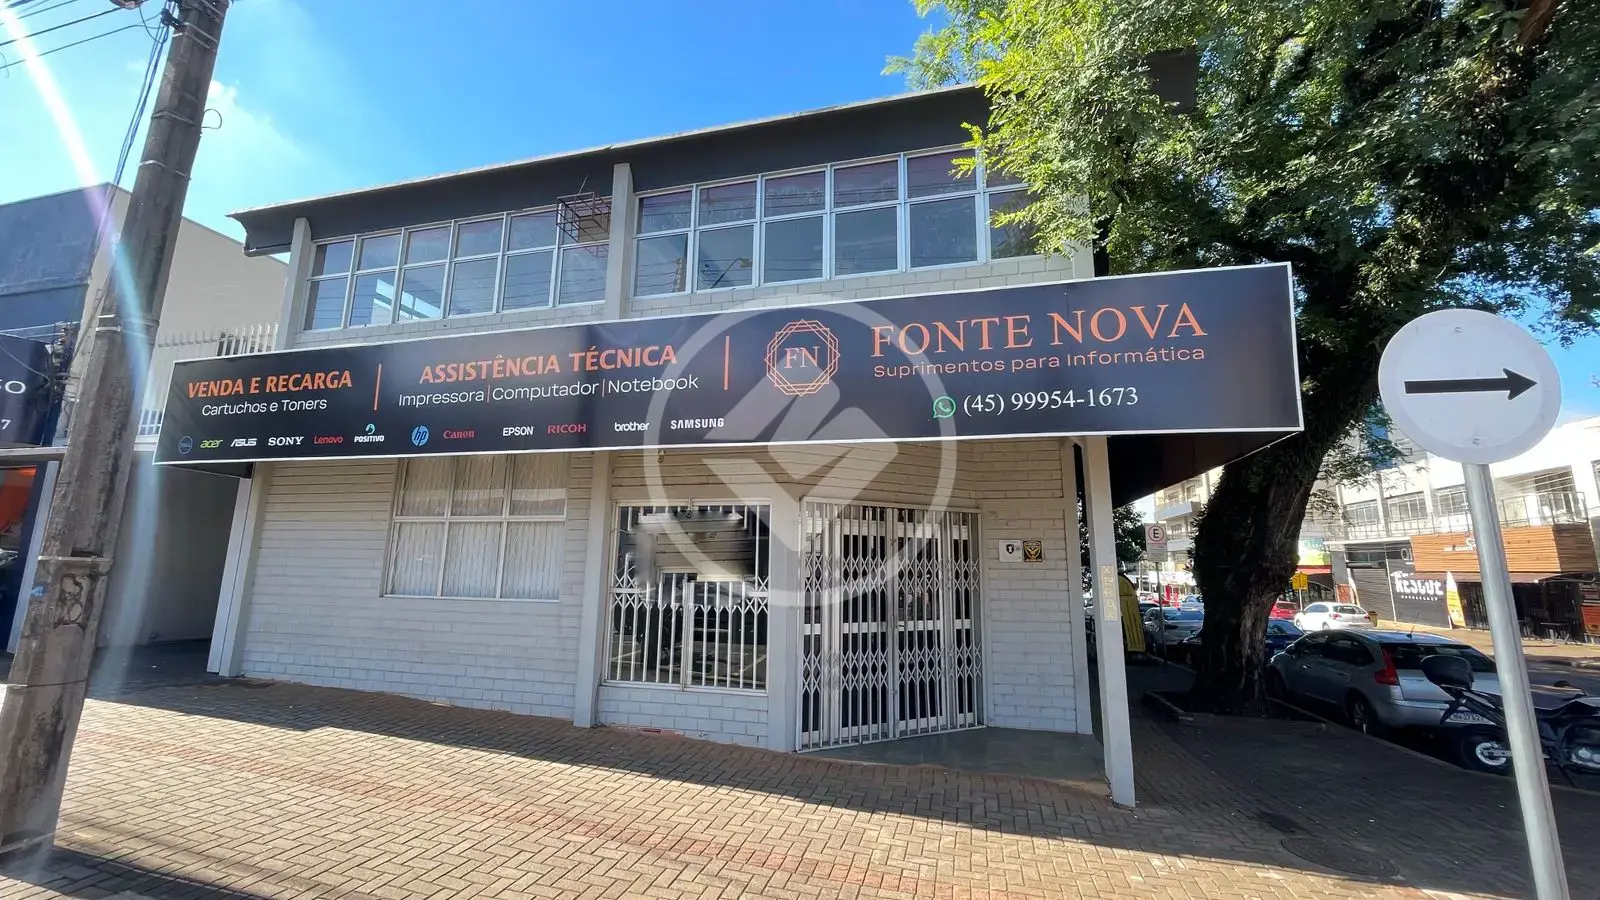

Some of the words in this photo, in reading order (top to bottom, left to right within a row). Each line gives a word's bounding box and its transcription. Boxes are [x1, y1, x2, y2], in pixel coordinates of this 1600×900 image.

[870, 315, 1034, 359] FONTE
[1048, 302, 1208, 346] NOVA
[782, 345, 821, 370] FN
[874, 359, 1005, 379] Suprimentos
[1011, 356, 1060, 373] para
[1067, 346, 1205, 367] Informática
[418, 353, 561, 385] ASSISTÊNCIA
[568, 344, 678, 373] TÉCNICA
[188, 378, 244, 399] VENDA
[249, 377, 261, 394] E
[265, 370, 353, 393] RECARGA
[398, 390, 485, 408] Impressora
[492, 380, 600, 402] Computador
[607, 375, 699, 394] Notebook
[963, 392, 1005, 416] (45)
[1011, 385, 1139, 411] 99954-1673
[201, 401, 268, 416] Cartuchos
[269, 401, 279, 413] e
[281, 398, 328, 412] Toners
[547, 423, 587, 434] RICOH
[614, 421, 651, 432] brother
[670, 417, 725, 430] SAMSUNG
[413, 426, 428, 445] hp
[442, 429, 475, 439] Canon
[502, 425, 534, 437] EPSON
[199, 439, 224, 449] acer
[230, 437, 258, 448] ASUS
[267, 436, 305, 447] SONY
[313, 435, 344, 445] Lenovo
[353, 434, 385, 443] POSITIVO
[1153, 528, 1160, 539] E
